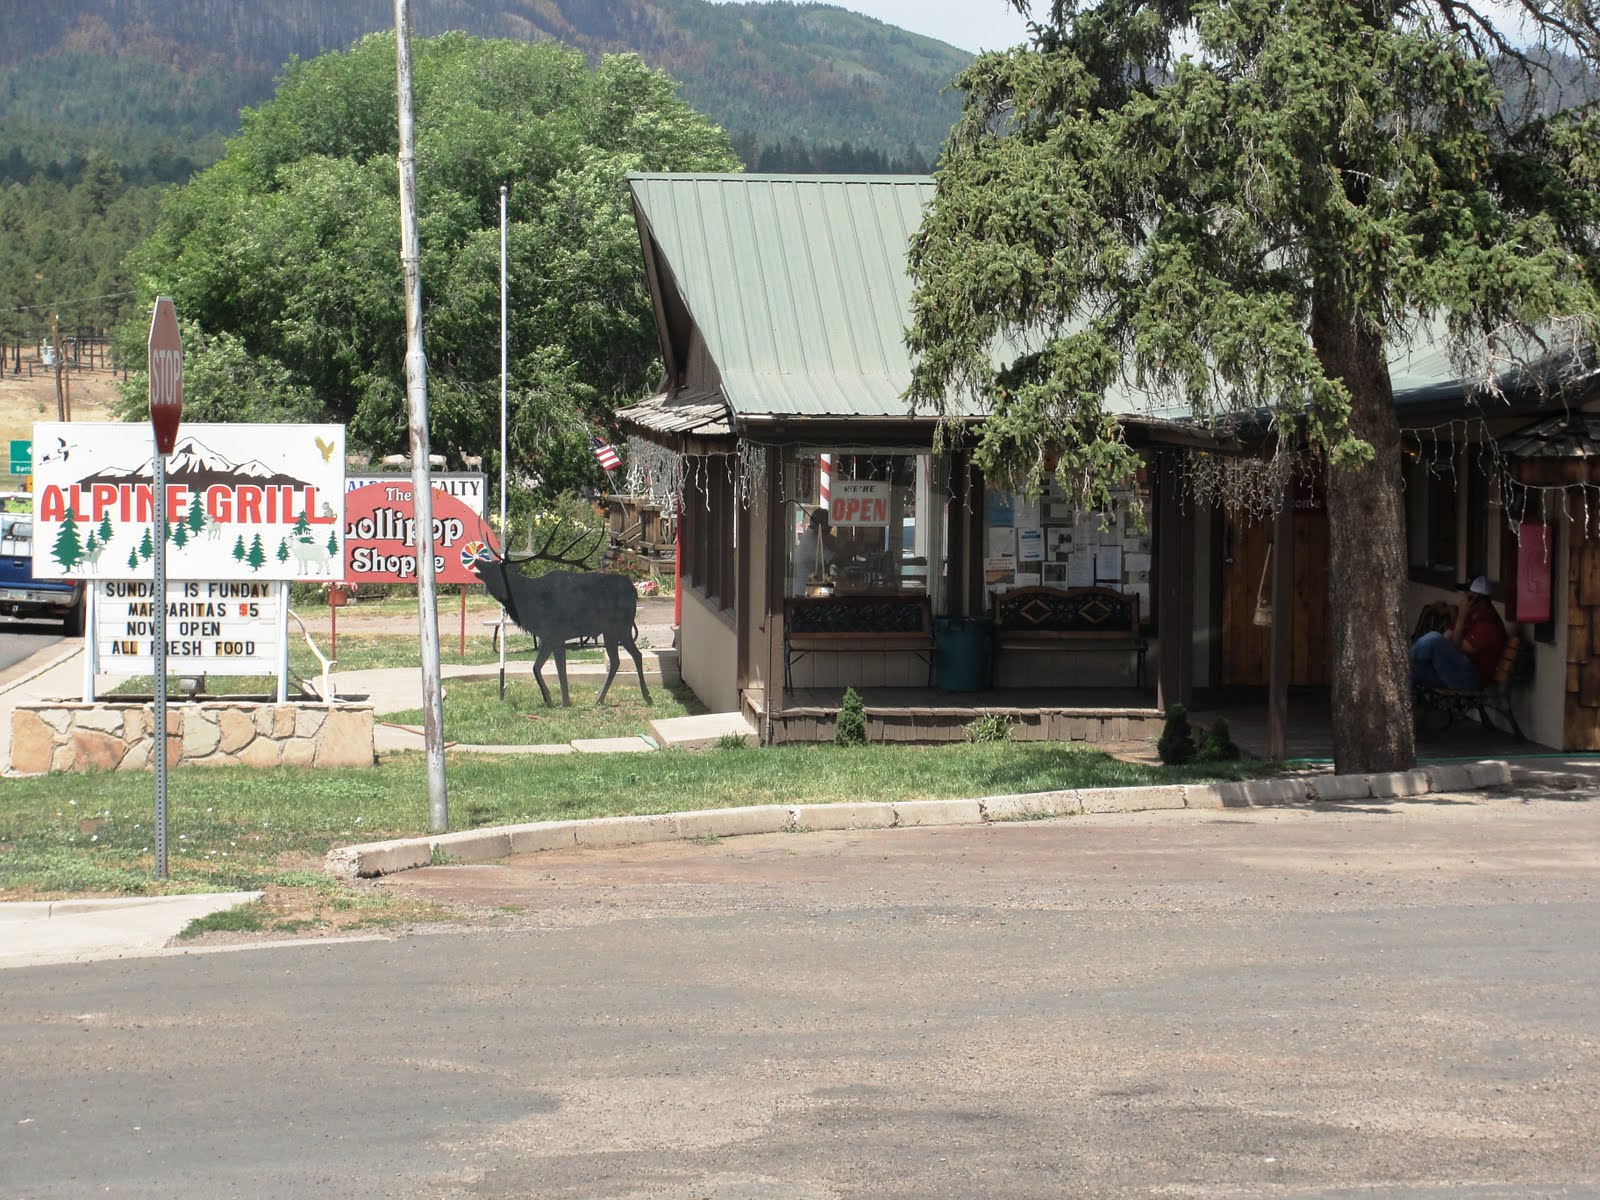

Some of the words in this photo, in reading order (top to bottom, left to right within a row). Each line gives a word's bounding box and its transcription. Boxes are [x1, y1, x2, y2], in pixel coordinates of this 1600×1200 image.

[152, 349, 181, 405] STOP
[384, 486, 412, 502] The
[430, 481, 480, 496] ALTY
[843, 485, 877, 493] WE'RE
[40, 484, 188, 523] ALPINE
[206, 485, 336, 525] GRILL
[832, 497, 888, 522] OPEN
[351, 547, 446, 578] Shope
[106, 582, 155, 598] SUNDA
[184, 582, 199, 598] IS
[208, 583, 270, 598] FUNDAY
[239, 603, 259, 618] $5
[180, 621, 221, 637] OPEN
[112, 640, 138, 655] ALL
[215, 641, 255, 656] FOOD
